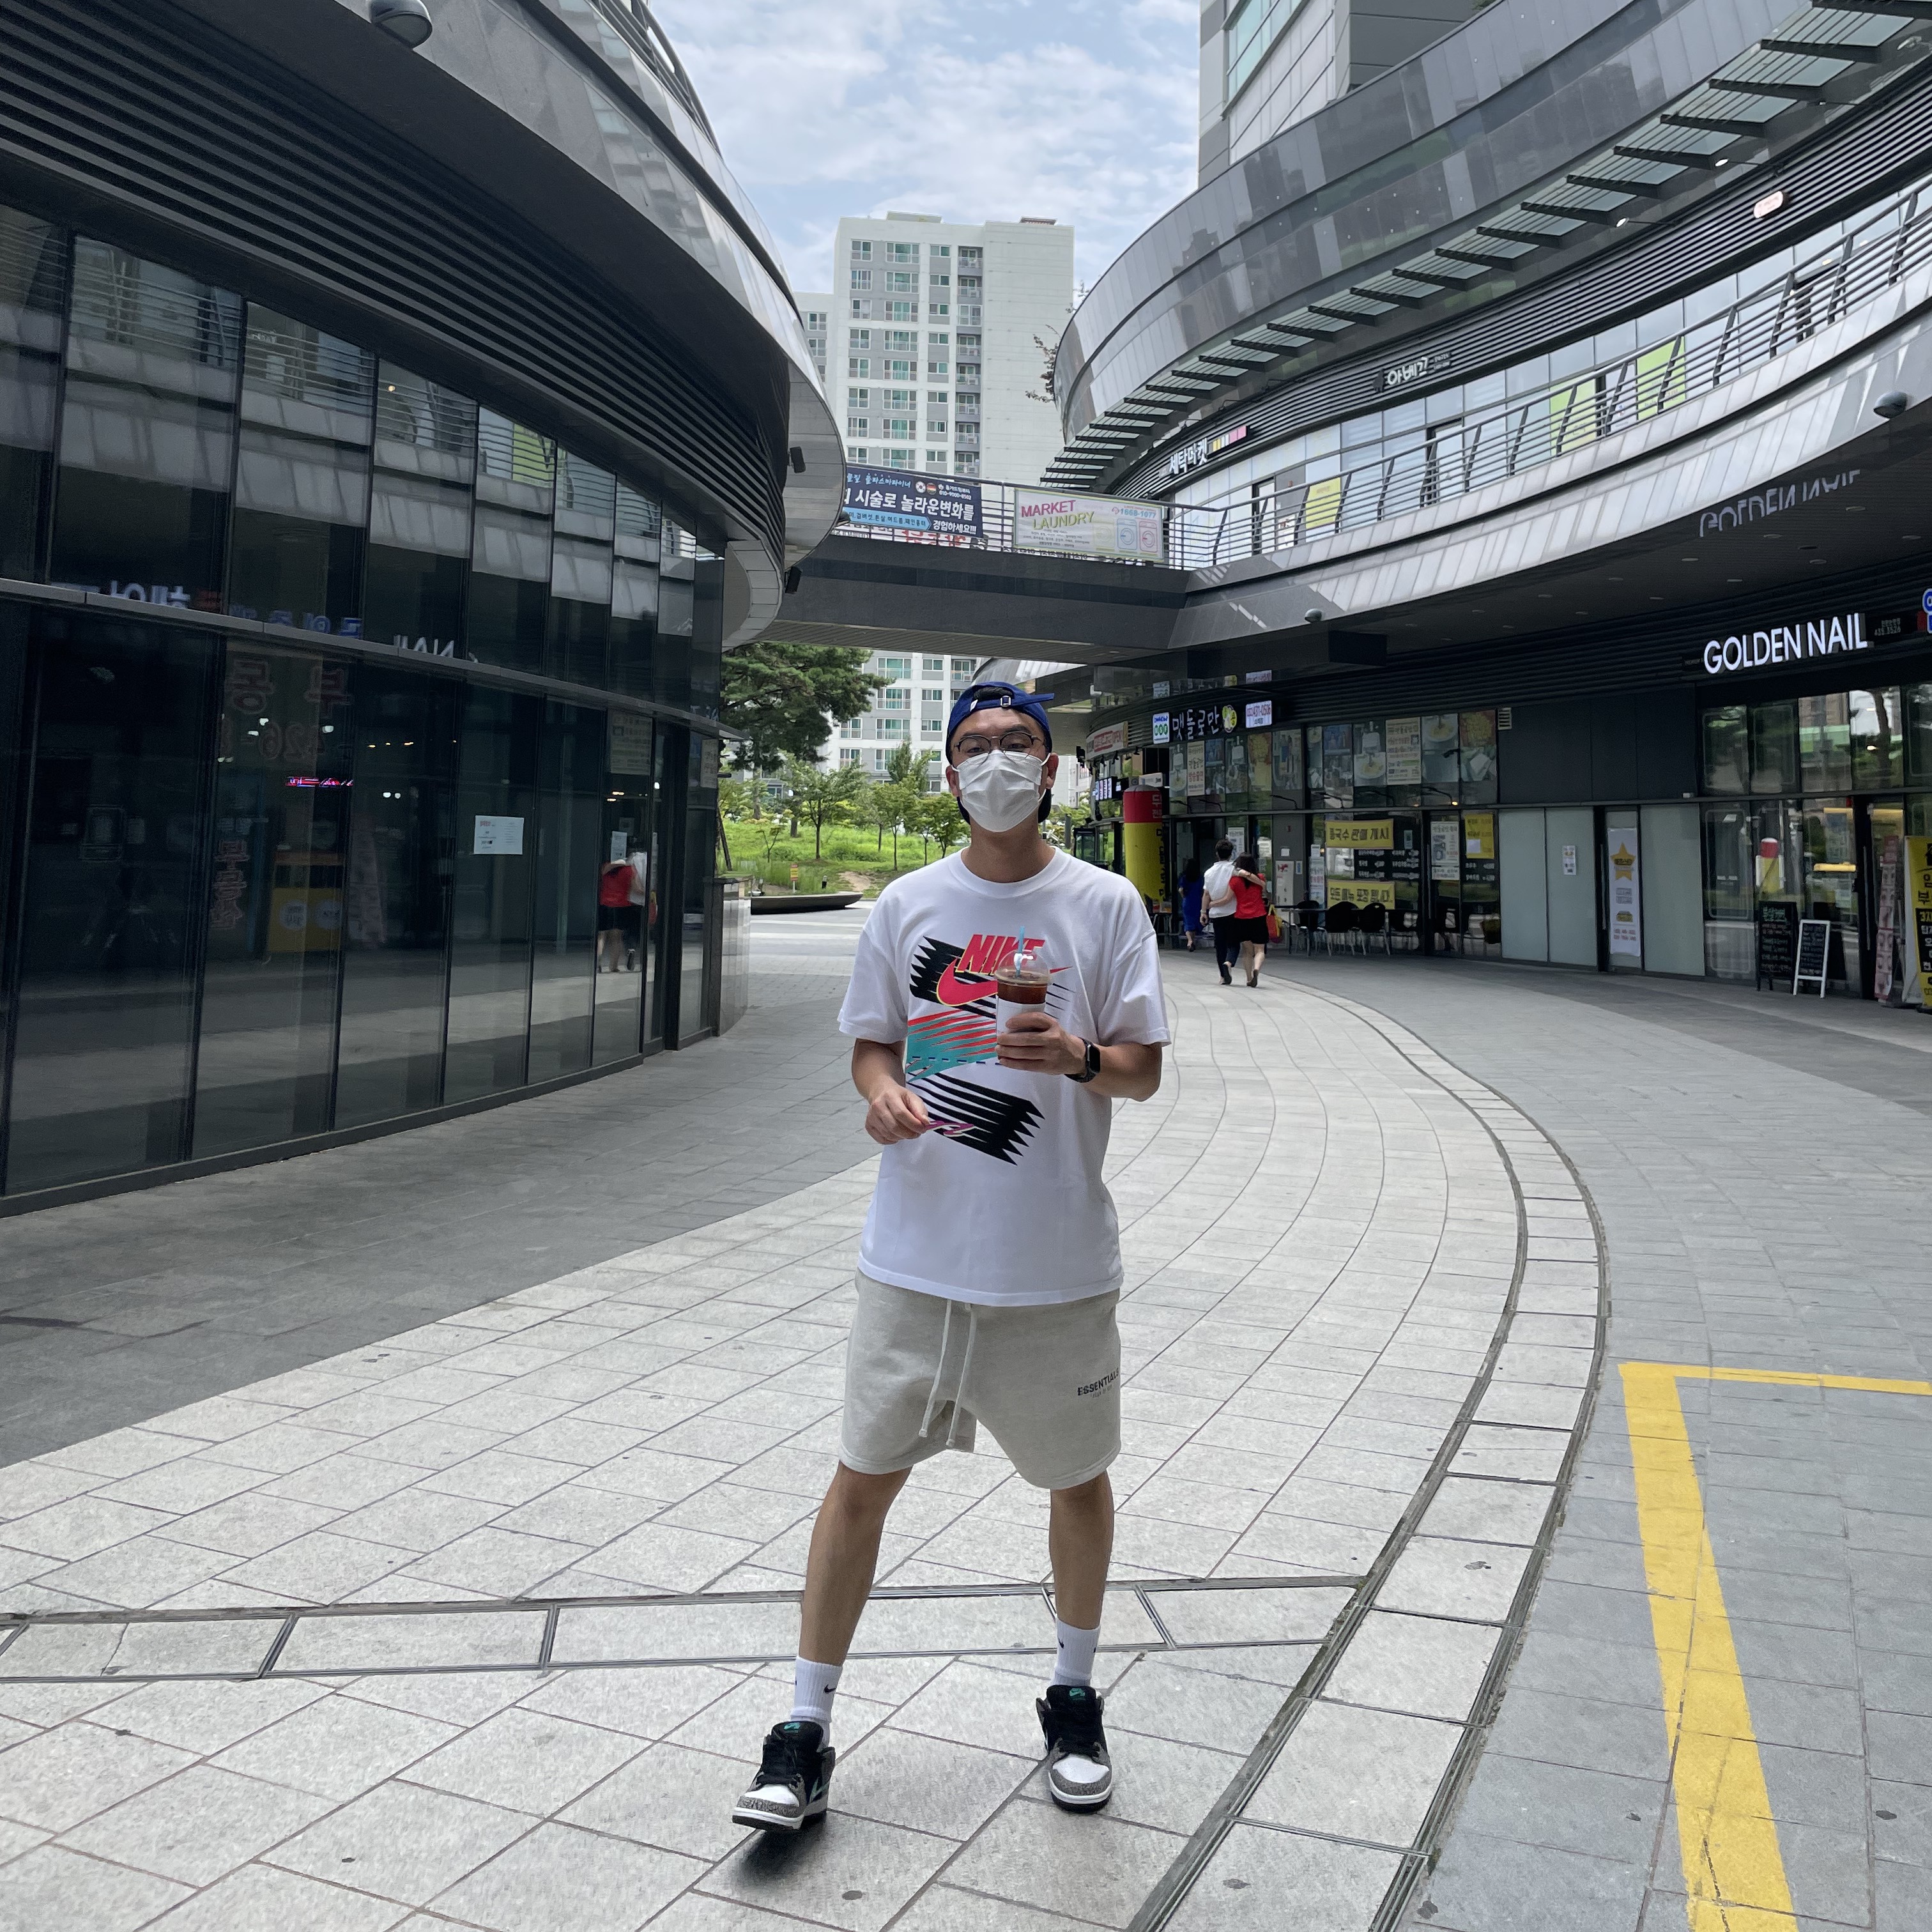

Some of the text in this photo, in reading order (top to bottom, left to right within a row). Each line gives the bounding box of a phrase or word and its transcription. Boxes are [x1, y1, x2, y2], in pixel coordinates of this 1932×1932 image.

[1169, 438, 1208, 474] 세탁마켓
[855, 489, 897, 508] 시술로
[1021, 500, 1076, 518] MARKET
[1032, 512, 1094, 530] LAUNDRY
[1704, 613, 1868, 674] GOLDEN NAIL
[1172, 705, 1220, 741] 맷돌로만
[955, 934, 1046, 976] NIKE
